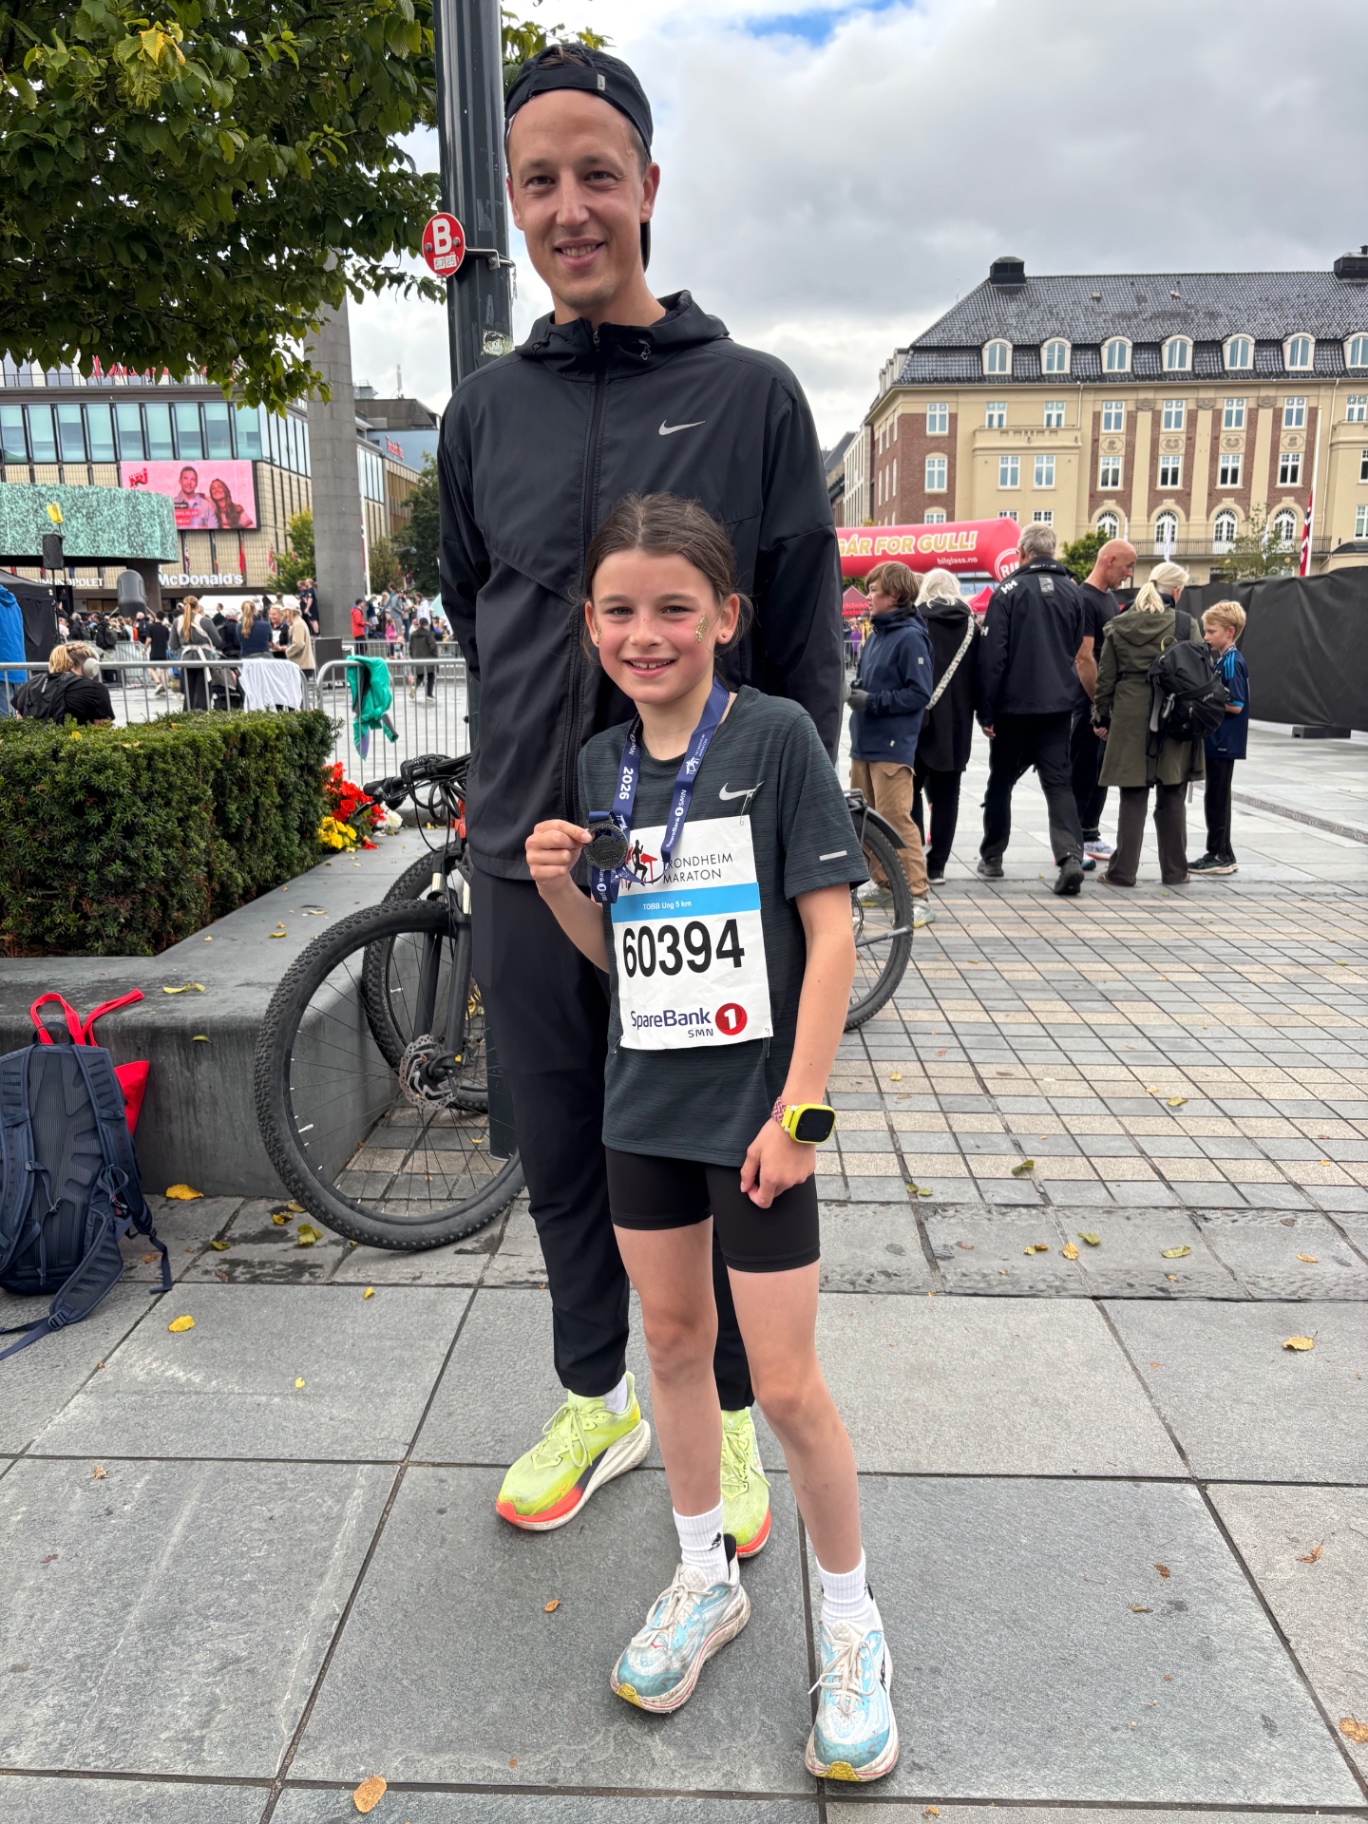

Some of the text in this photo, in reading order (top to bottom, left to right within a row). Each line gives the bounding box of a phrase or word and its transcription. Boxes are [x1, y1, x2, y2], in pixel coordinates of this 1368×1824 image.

[432, 218, 452, 255] B
[874, 536, 915, 556] FOR
[917, 531, 978, 554] GULL!
[937, 557, 978, 565] bilglass.no
[158, 573, 243, 585] McDonald's
[619, 766, 634, 800] 2026
[679, 789, 687, 806] SMN
[669, 853, 734, 869] RONDHEIM
[663, 868, 722, 884] MARATON
[661, 902, 674, 910] Ung
[623, 919, 745, 978] 60394
[631, 1007, 712, 1030] SpareBank
[688, 1028, 714, 1038] SMN
